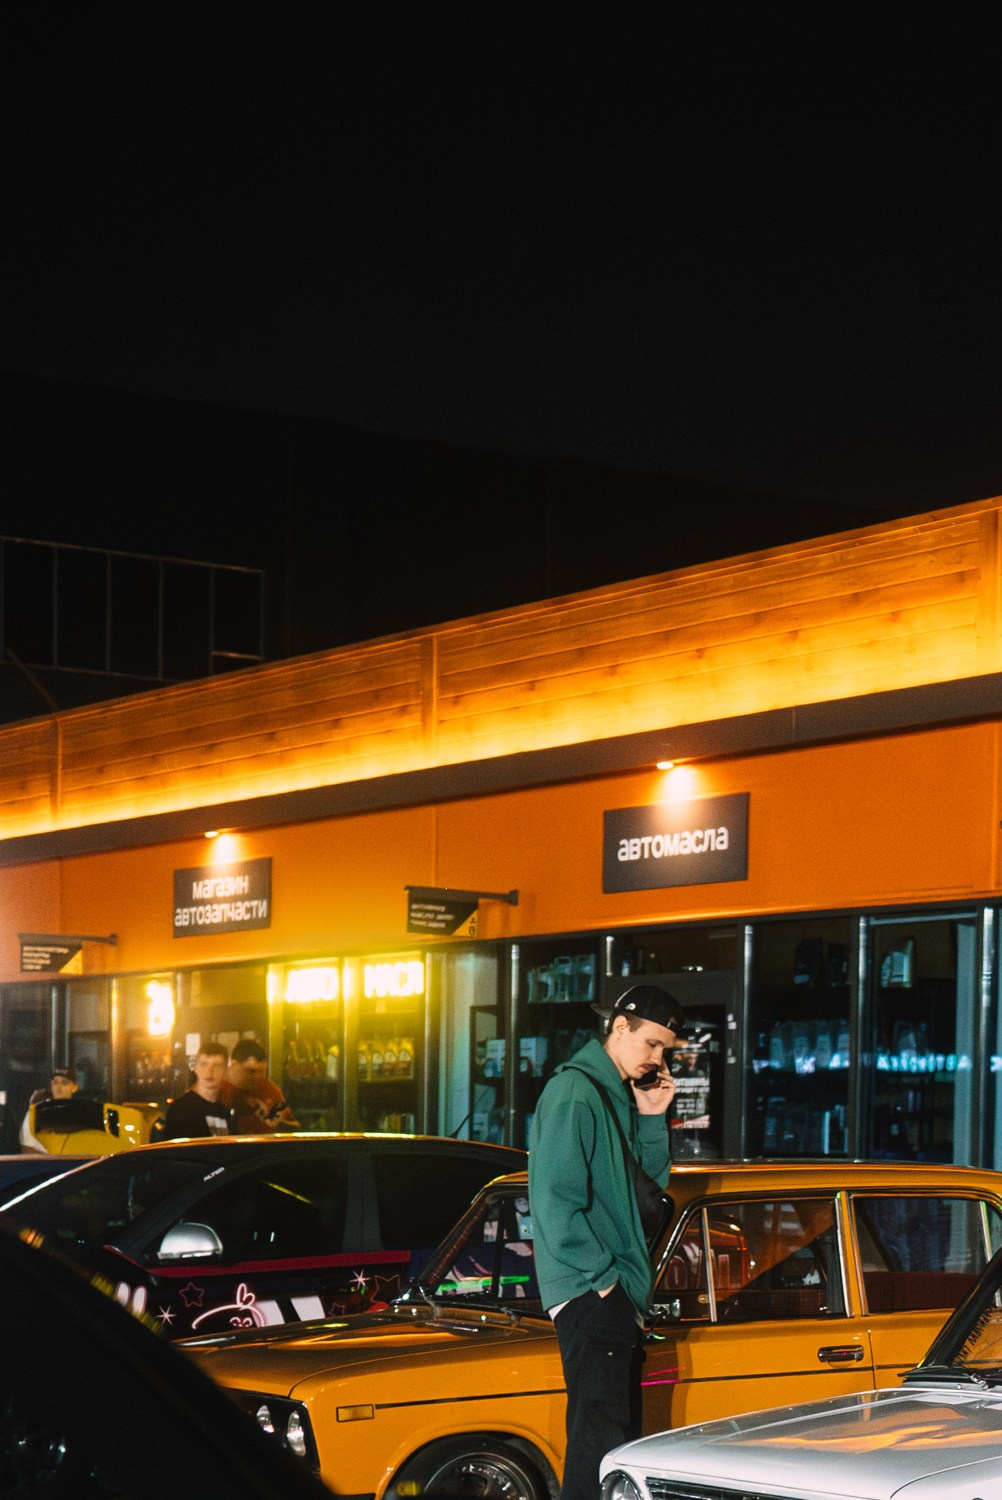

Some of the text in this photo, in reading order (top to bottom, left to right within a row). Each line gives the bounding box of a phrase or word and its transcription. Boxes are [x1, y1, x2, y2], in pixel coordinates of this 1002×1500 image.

[618, 827, 729, 861] автомасла
[193, 875, 249, 900] магазин
[174, 900, 267, 927] автозапчасти
